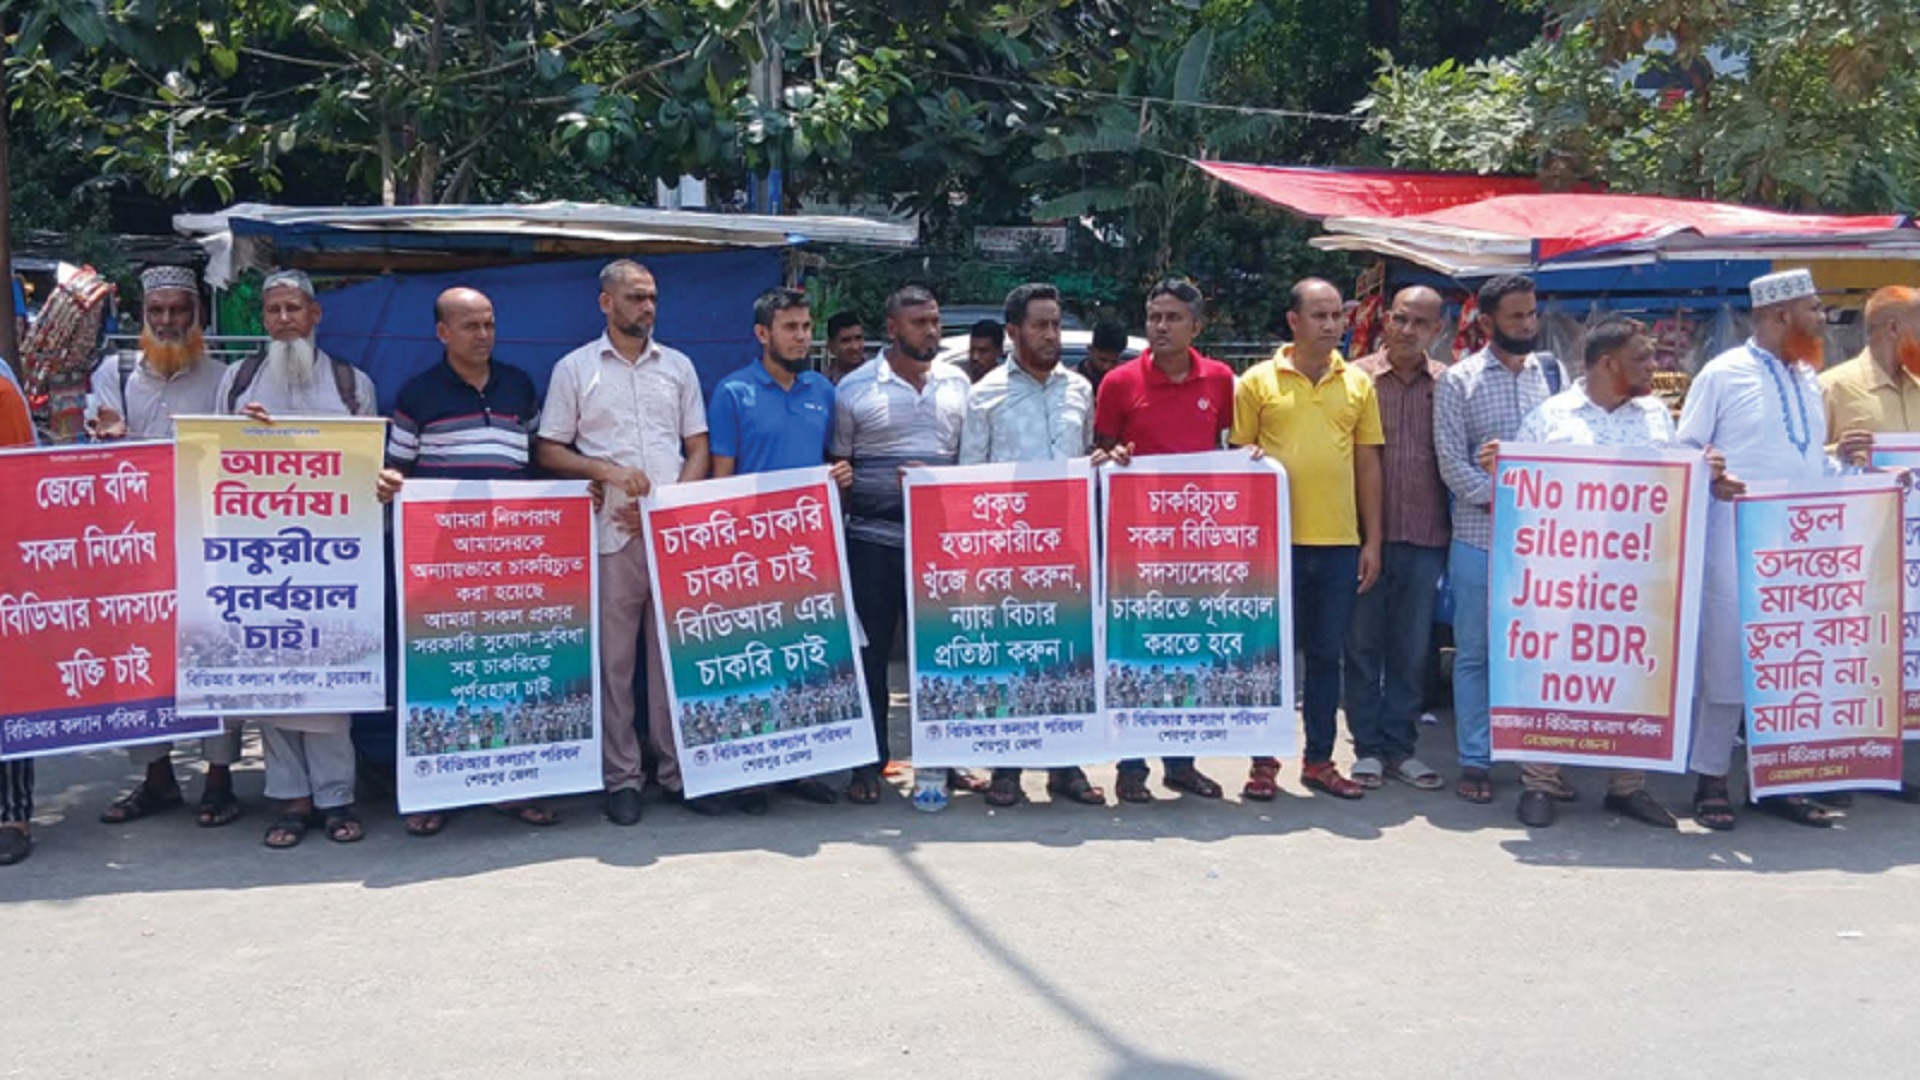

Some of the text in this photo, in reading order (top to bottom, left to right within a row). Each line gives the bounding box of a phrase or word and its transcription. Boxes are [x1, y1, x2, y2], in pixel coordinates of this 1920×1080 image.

[220, 450, 342, 479] আমরা
[37, 461, 149, 509] জেলে বন্দি
[1147, 482, 1240, 517] চাকরিচ্যুত
[1576, 481, 1669, 514] more
[434, 506, 563, 529] আমরা নিরপরাধ
[972, 492, 1030, 527] প্রকৃত
[1787, 503, 1847, 543] ভুল
[18, 520, 157, 571] সকল নির্দোষ
[202, 527, 361, 575] চাকুরীতে
[453, 535, 546, 552] আমাদেরকে
[939, 520, 1062, 559] হত্যাকারীকে
[1126, 517, 1260, 549] সকল বিডিআর
[1514, 518, 1652, 562] silence!
[683, 543, 817, 597] চাকরি চাই
[1137, 561, 1250, 585] সদস্যদেরকে
[1754, 545, 1864, 578] তদন্তের
[456, 582, 546, 602] করা হয়েছে
[922, 561, 969, 600] খুঁজে
[975, 567, 1014, 592] বের
[1511, 567, 1638, 612] Justice
[1758, 581, 1866, 613] মাধ্যমে
[0, 592, 91, 636] বিডিআর
[206, 576, 358, 624] পূনর্বহাল
[424, 605, 575, 629] আমরা সকল প্রকার
[948, 596, 1058, 632] ন্যায় বিচার
[1111, 589, 1193, 621] চাকরিতে
[673, 592, 837, 645] বিডিআর এর
[412, 631, 477, 655] সরকারি
[933, 632, 1000, 669] প্রতিষ্ঠা
[1142, 632, 1245, 658] করতে হবে
[1507, 619, 1655, 673] for BDR,
[1745, 621, 1804, 660] ভুল
[56, 643, 154, 698] মুক্তি চাই
[450, 651, 552, 678] সহ চাকরিতে
[695, 632, 830, 686] চাকরি চাই
[1754, 649, 1825, 691] মানি
[522, 675, 553, 698] চাই
[1541, 672, 1616, 704] now
[1753, 691, 1823, 732] মানি
